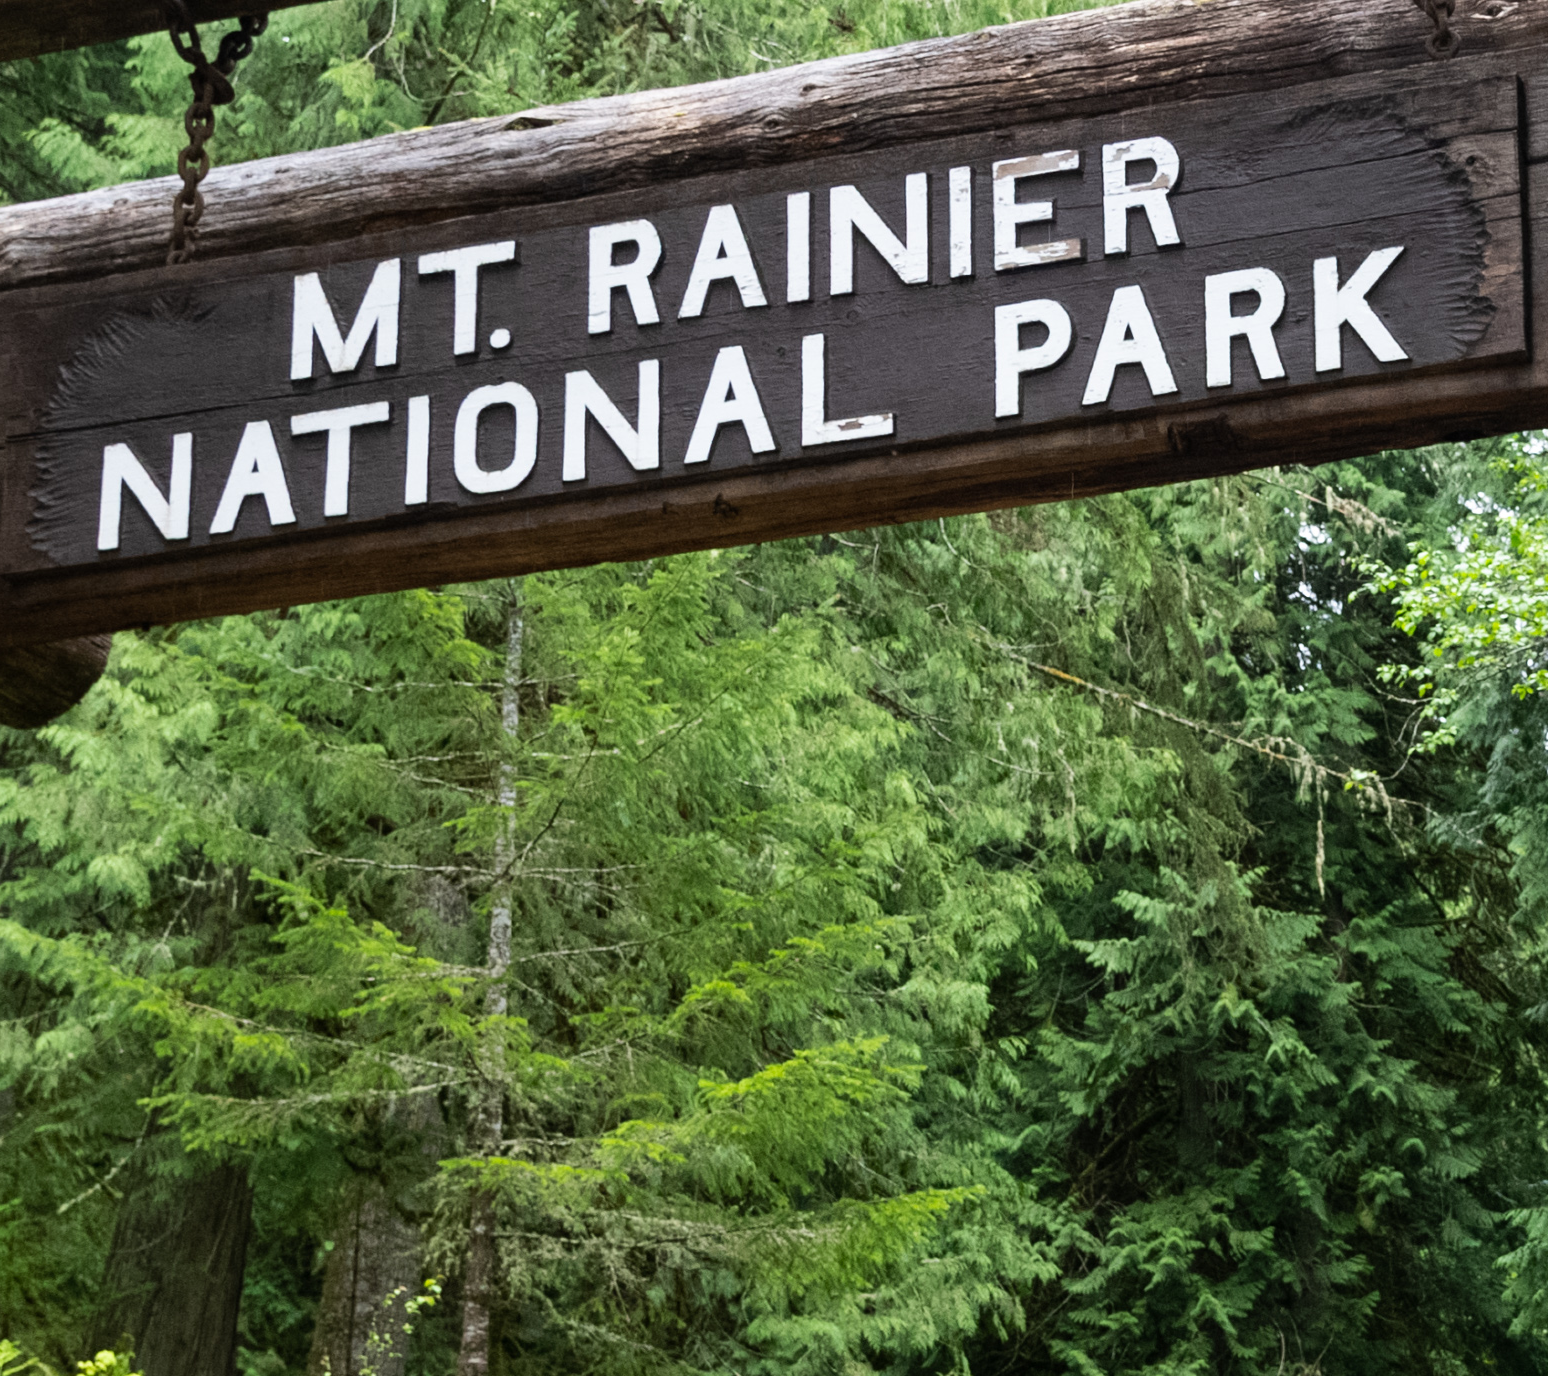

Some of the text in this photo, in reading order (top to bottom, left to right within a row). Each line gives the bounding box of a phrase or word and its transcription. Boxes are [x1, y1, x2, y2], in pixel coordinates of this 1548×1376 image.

[290, 135, 1181, 380] MT. RAINIER
[97, 245, 1409, 550] NATIONAL PARK
